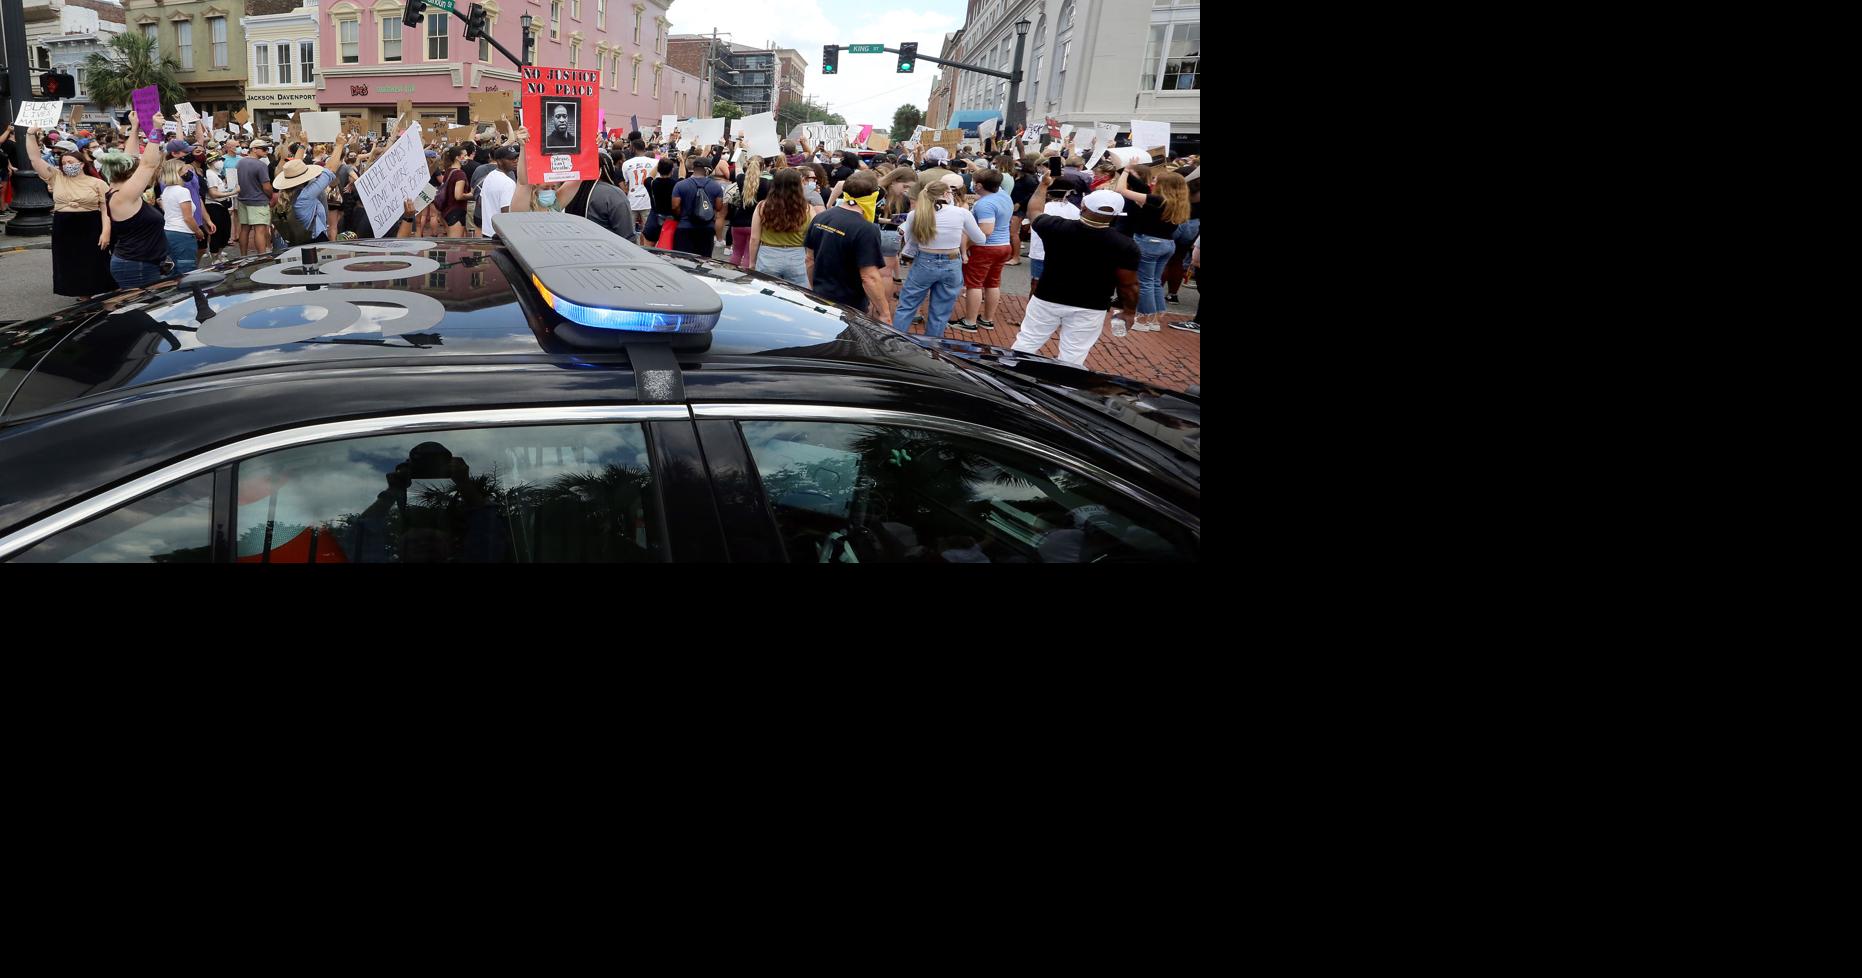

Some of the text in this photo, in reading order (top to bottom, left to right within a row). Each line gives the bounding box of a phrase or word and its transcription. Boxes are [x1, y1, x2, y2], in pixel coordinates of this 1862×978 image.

[523, 68, 597, 82] NO JUSTICE
[528, 82, 593, 96] NO PEACE
[24, 101, 57, 111] BLACK
[359, 162, 388, 197] THERE
[384, 143, 407, 172] COMES
[370, 187, 388, 212] TIME
[374, 197, 401, 228] SILENCE
